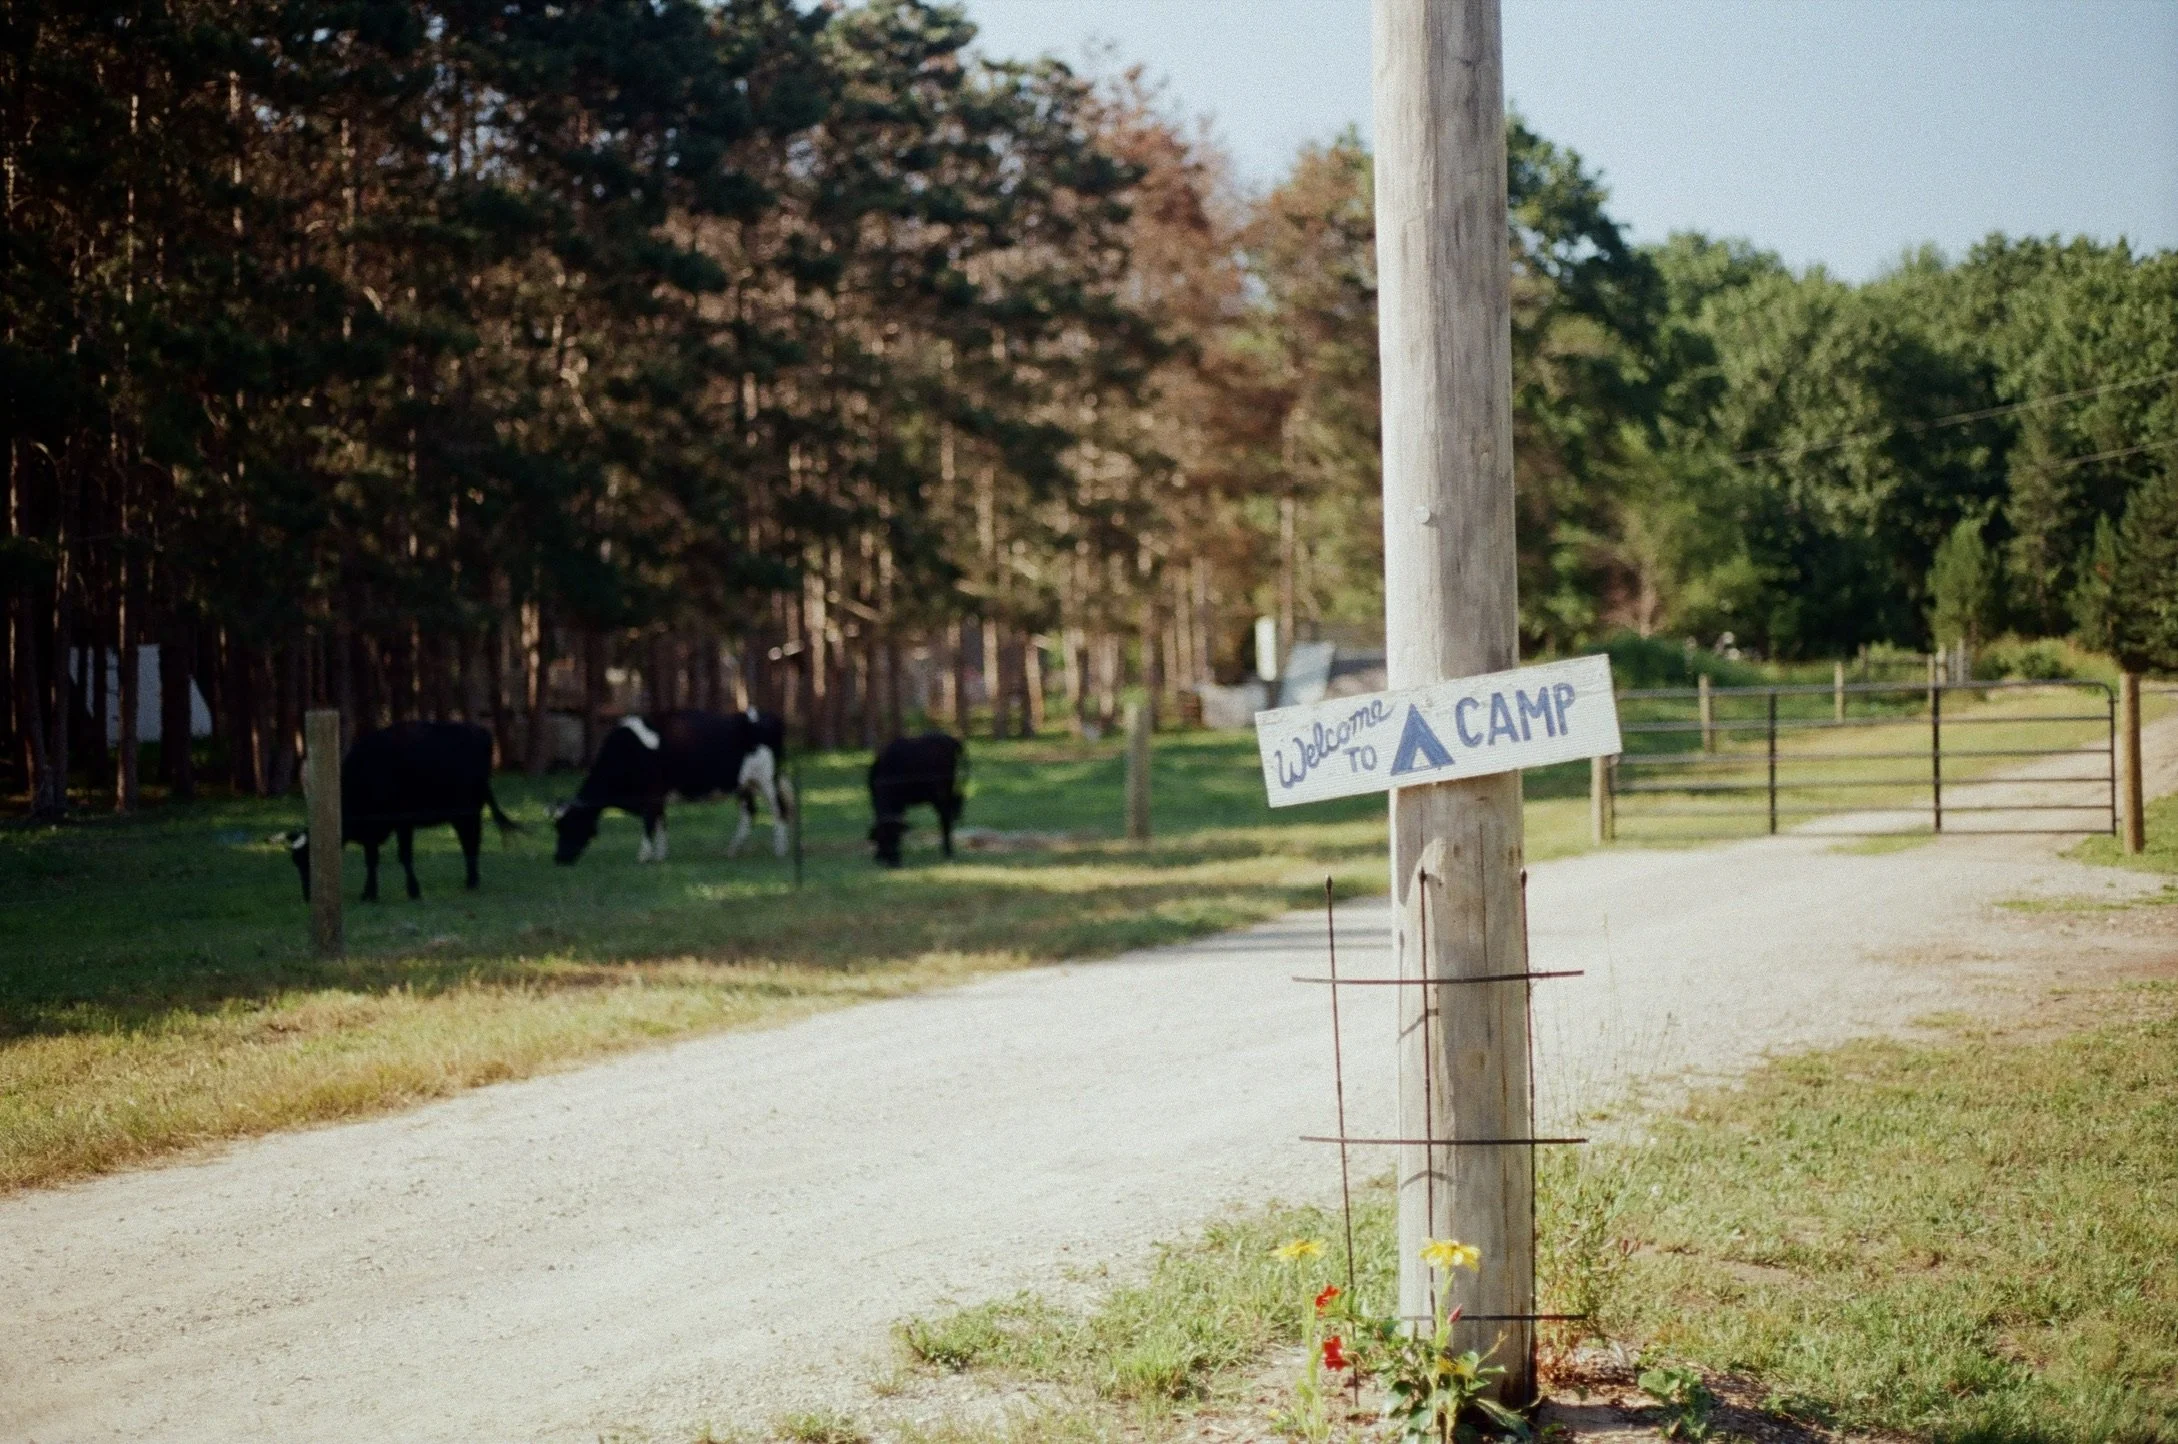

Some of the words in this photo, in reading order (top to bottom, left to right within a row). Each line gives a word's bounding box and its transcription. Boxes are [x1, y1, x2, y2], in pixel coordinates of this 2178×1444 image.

[1275, 699, 1393, 789] Welcome
[1454, 682, 1576, 748] CAMP
[1343, 744, 1378, 773] TO
